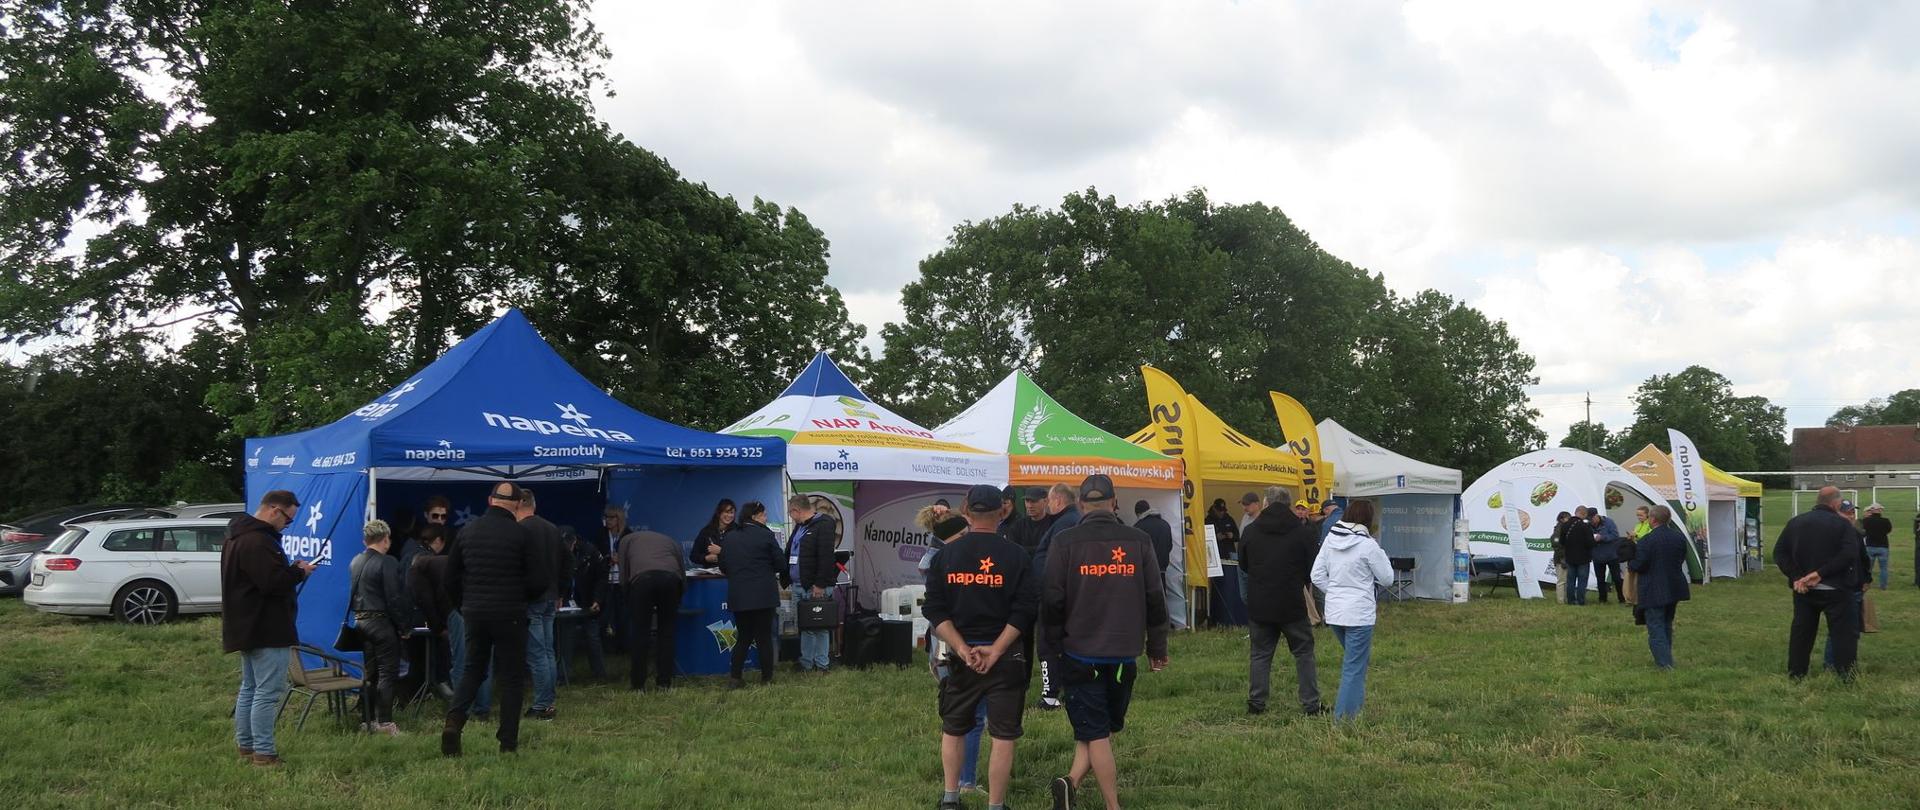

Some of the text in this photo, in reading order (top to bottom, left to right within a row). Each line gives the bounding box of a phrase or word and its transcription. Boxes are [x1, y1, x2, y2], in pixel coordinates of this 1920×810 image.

[482, 411, 635, 442] napena
[811, 418, 934, 439] NAP Amino
[405, 444, 763, 462] napena Szamotuły tel. 661 934 325
[814, 459, 859, 473] napena
[955, 466, 989, 478] DOLISTNE
[1019, 462, 1175, 481] www.nasiona-wronkowski.pl
[863, 521, 929, 549] Nanoplant
[947, 572, 1003, 586] napena
[1080, 563, 1135, 577] napena
